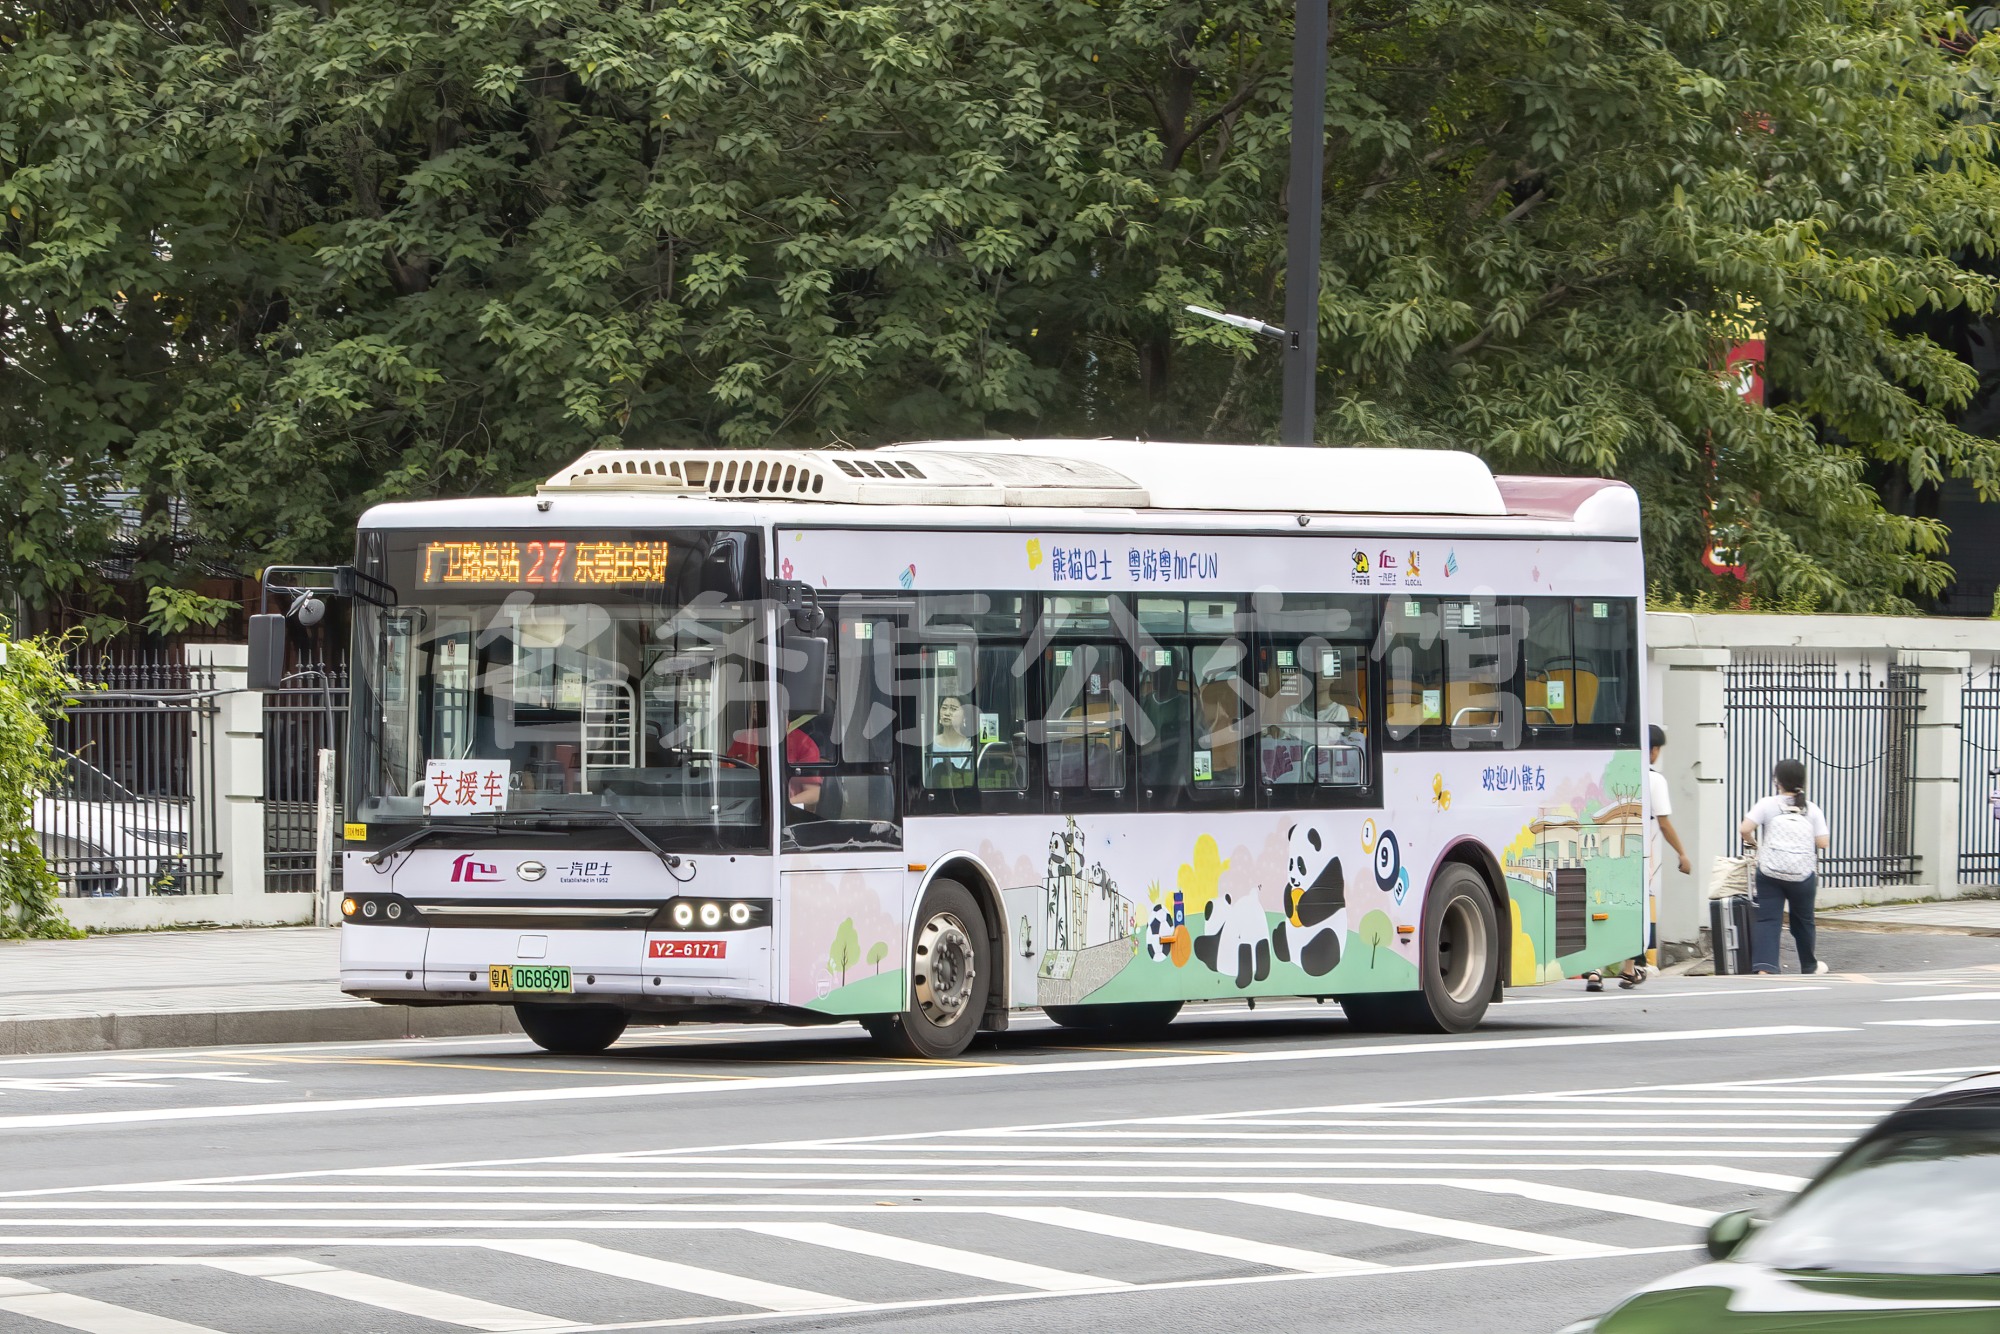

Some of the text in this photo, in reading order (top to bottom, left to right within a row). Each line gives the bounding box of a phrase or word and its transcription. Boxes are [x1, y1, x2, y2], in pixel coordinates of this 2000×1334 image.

[423, 540, 668, 583] 广卫路总站 27 东莞庄总站
[1052, 546, 1218, 582] 熊猫巴士 粤游粤加FUN
[429, 769, 503, 807] 支援车
[1482, 764, 1546, 792] 欢迎小熊友
[556, 861, 613, 877] 一汽巴士
[1381, 846, 1389, 868] 9
[655, 941, 720, 958] Y2-6171
